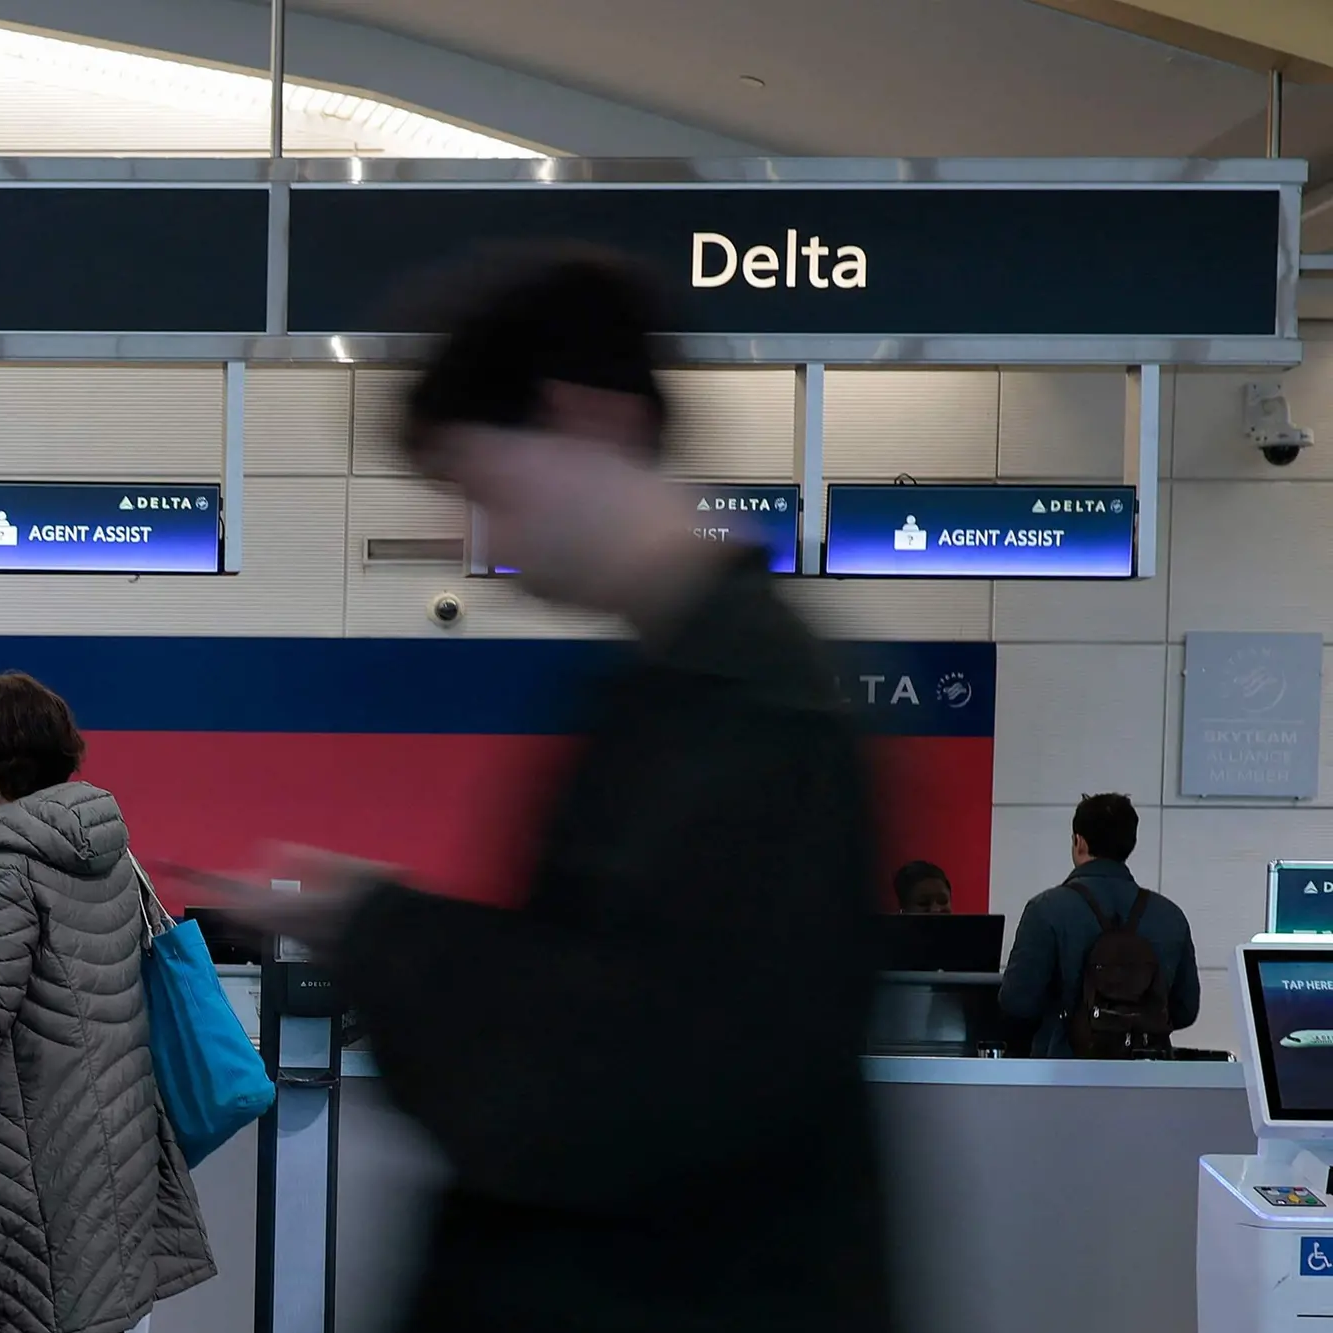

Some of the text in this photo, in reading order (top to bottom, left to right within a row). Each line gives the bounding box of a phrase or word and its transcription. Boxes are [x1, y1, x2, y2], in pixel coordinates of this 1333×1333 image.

[692, 228, 867, 288] Delta
[137, 497, 192, 510] DELTA
[715, 498, 771, 511] DELTA
[1050, 500, 1106, 513] DELTA
[28, 525, 152, 543] AGENT ASSIST
[693, 527, 729, 542] SIST
[938, 529, 1065, 547] AGENT ASSIST
[1282, 980, 1333, 991] TAP HERE
